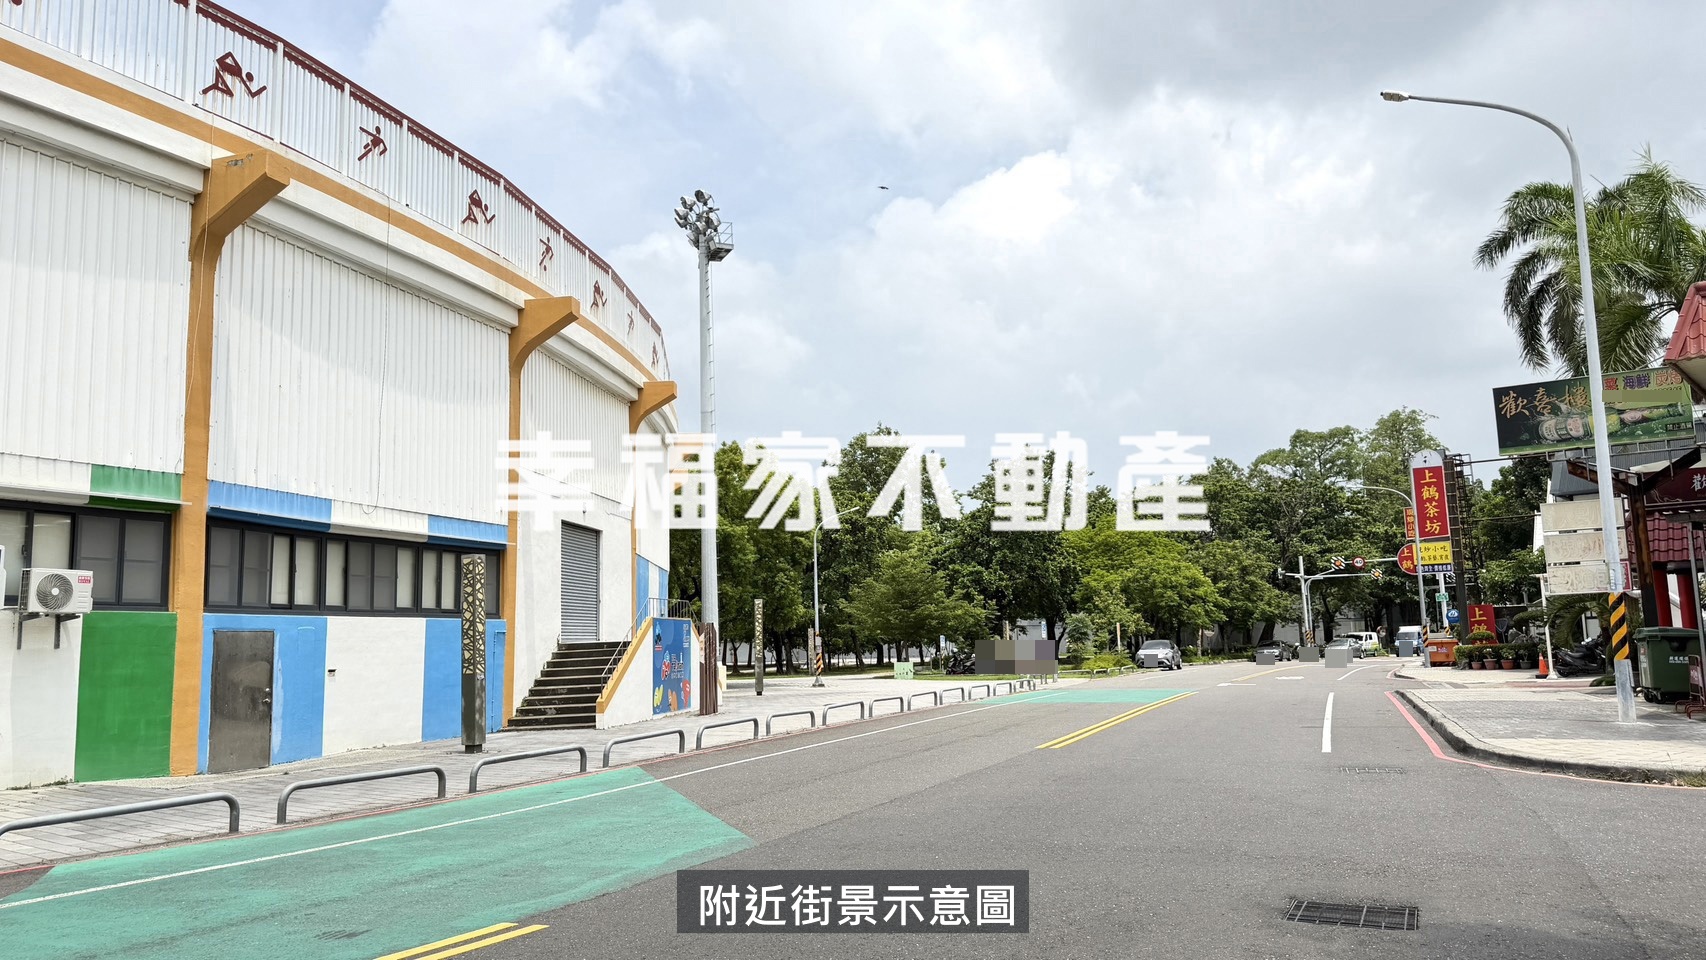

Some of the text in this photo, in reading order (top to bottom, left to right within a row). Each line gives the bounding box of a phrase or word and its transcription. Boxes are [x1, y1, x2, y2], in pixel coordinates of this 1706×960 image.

[1499, 382, 1591, 418] 歡喜樓
[1420, 469, 1442, 535] 上鶴茶坊
[1401, 547, 1414, 570] 上鶴
